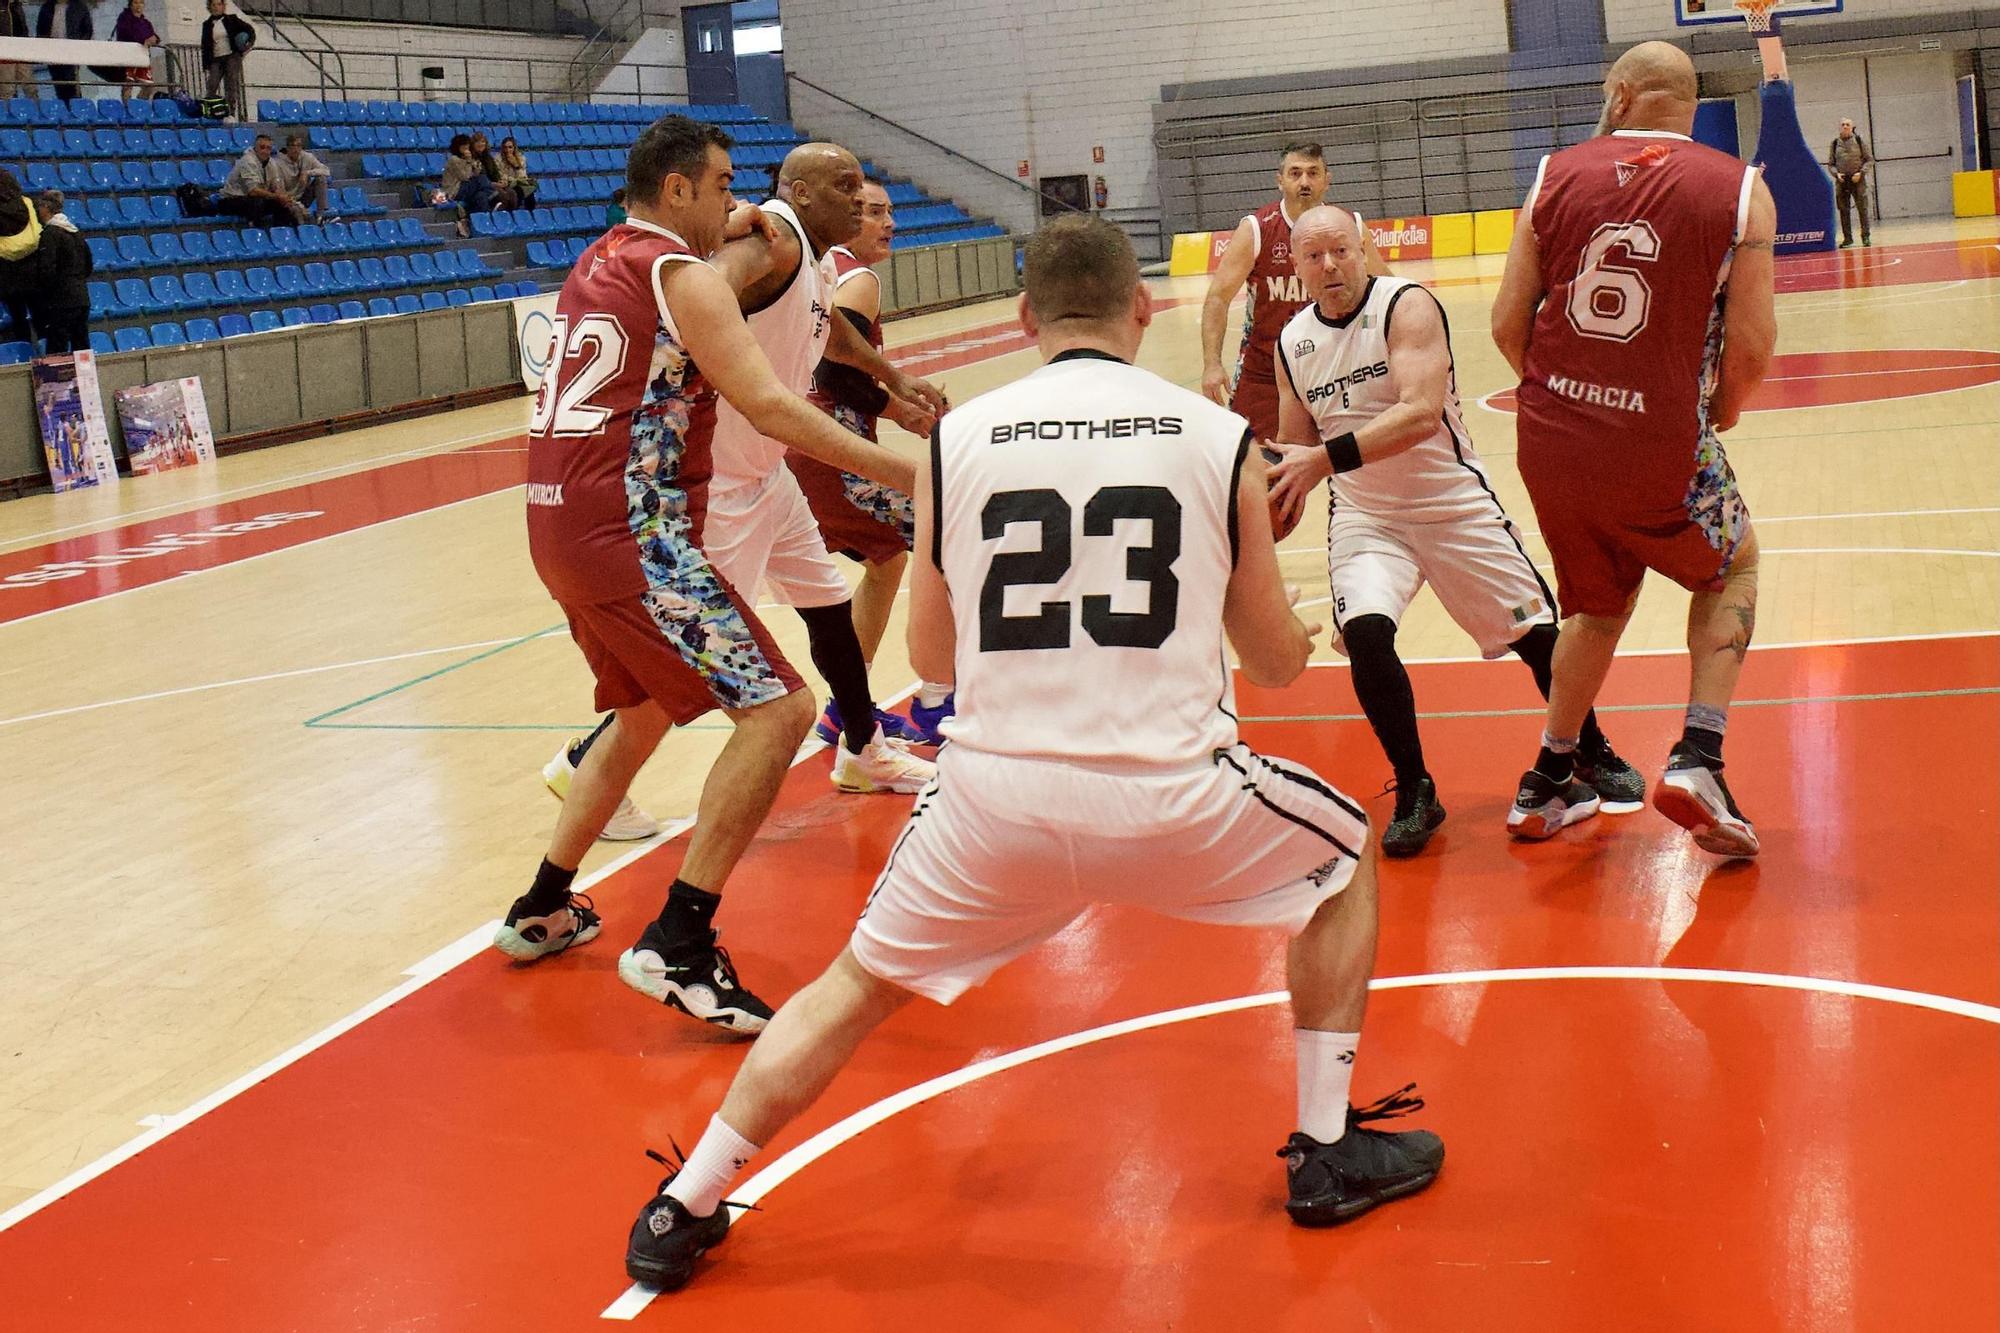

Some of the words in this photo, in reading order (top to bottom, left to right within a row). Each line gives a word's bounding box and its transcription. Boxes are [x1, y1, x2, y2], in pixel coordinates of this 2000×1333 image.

[1369, 224, 1428, 248] Murcia
[1784, 230, 1825, 243] SYSTEM
[1565, 218, 1661, 343] 6
[1305, 360, 1389, 404] BROTHERS
[1547, 374, 1647, 414] MURCIA
[1342, 391, 1350, 409] 6
[990, 416, 1184, 445] BROTHERS
[527, 483, 565, 506] MURCIA
[979, 485, 1183, 652] 23
[1337, 595, 1346, 614] 6
